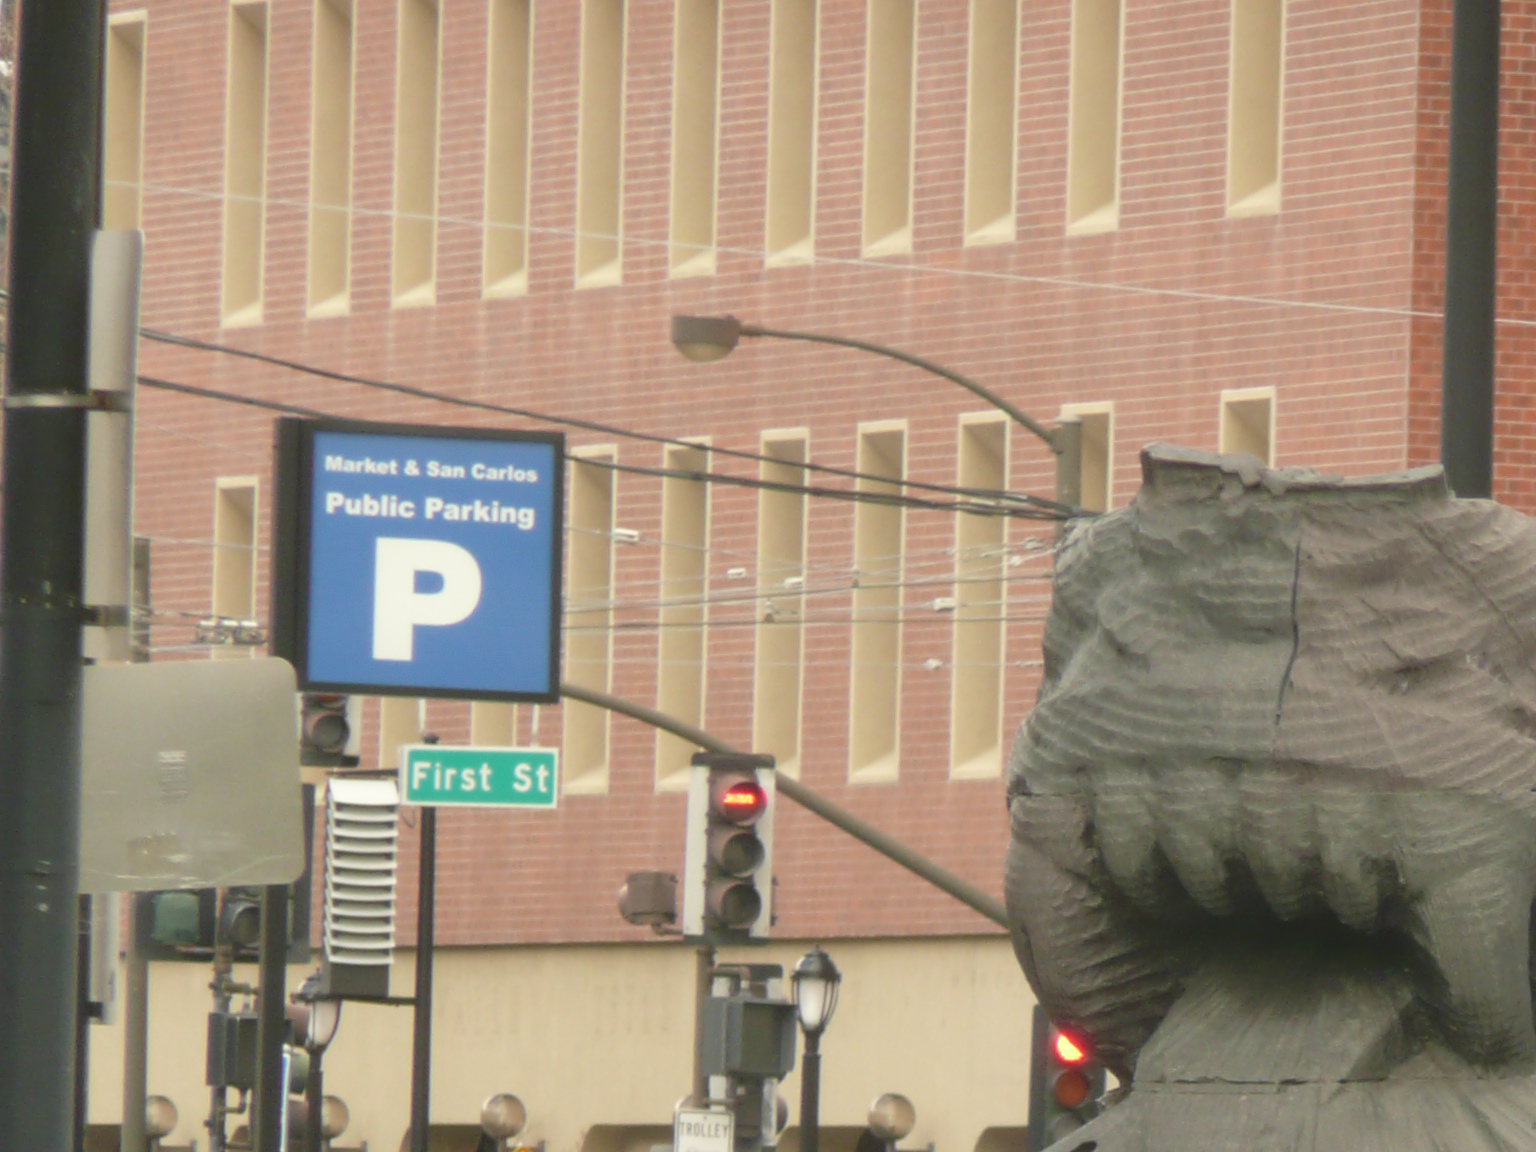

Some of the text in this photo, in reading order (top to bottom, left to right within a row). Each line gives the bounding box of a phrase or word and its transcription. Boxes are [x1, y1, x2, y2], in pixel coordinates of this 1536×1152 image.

[325, 456, 539, 483] Market & San Carlos
[326, 492, 536, 530] Public Parking
[372, 536, 483, 662] P
[412, 761, 550, 793] First St
[680, 1121, 730, 1137] TROLLEY
